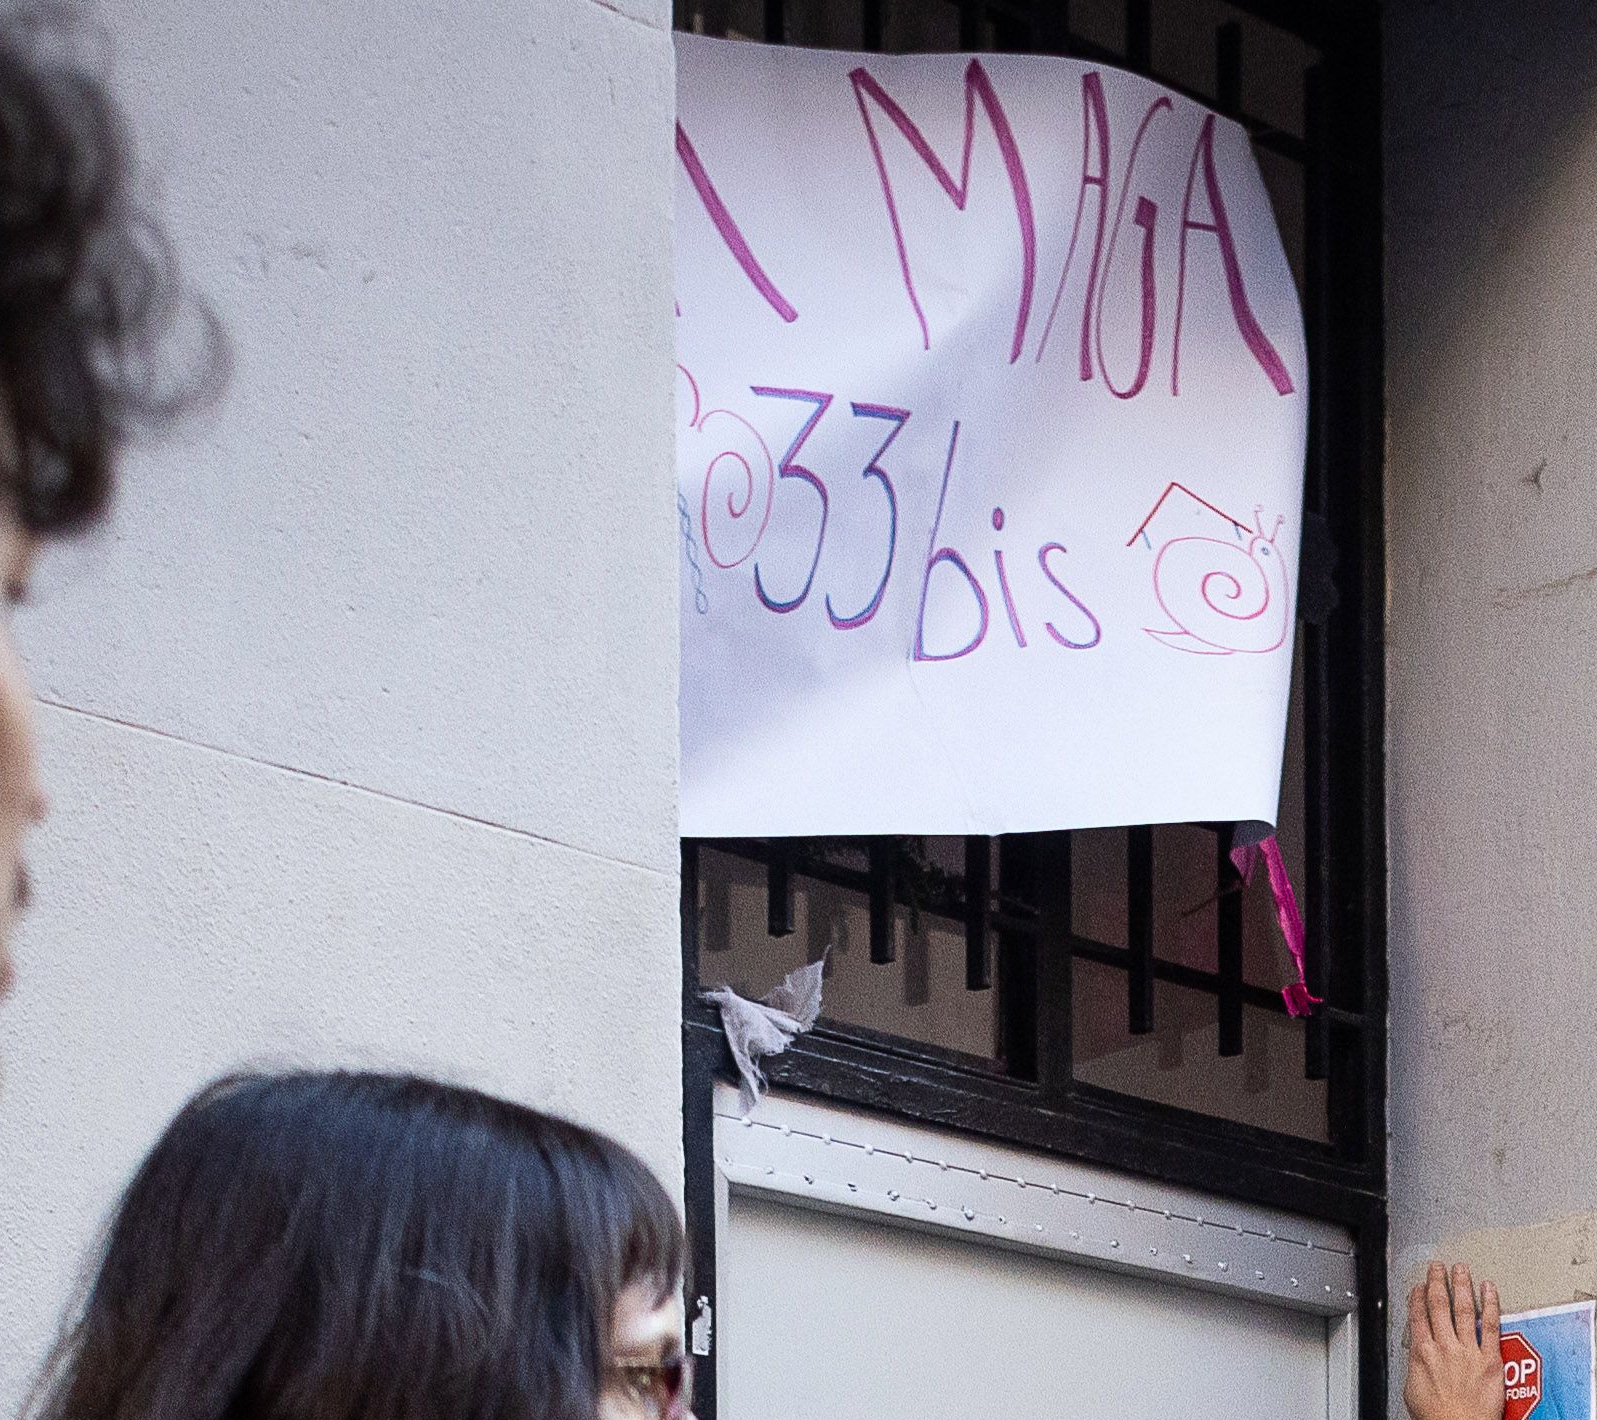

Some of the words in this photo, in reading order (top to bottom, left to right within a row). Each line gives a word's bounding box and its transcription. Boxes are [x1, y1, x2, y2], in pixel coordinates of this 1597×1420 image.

[848, 58, 1296, 401] MAGA
[1503, 1358, 1537, 1387] OP
[1506, 1385, 1539, 1402] FOBIA
